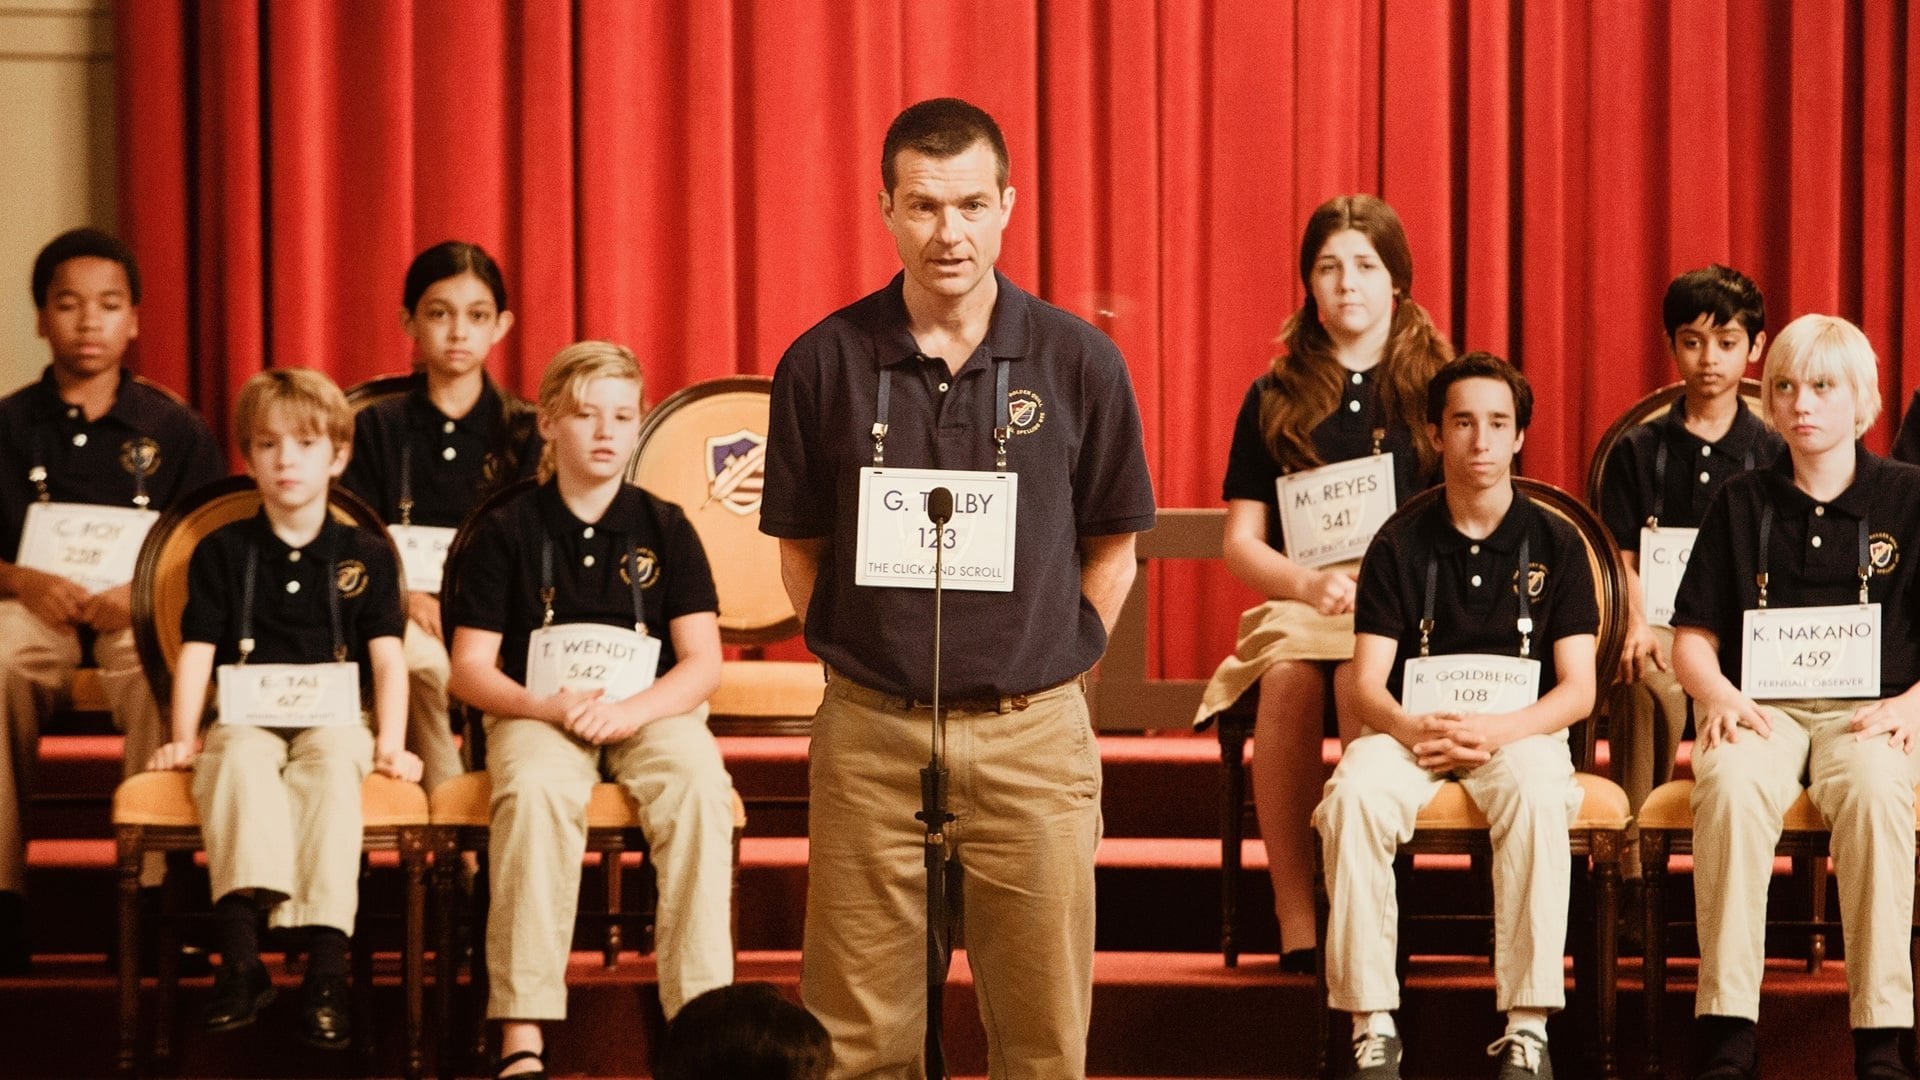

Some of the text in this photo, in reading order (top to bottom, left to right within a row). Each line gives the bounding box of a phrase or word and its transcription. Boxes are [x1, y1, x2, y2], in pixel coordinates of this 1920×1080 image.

[1295, 474, 1378, 508] M. REYES
[883, 490, 993, 514] G. TLBY
[1322, 509, 1351, 531] 341
[918, 527, 956, 549] 123
[1653, 547, 1670, 564] C.
[868, 562, 1002, 578] THE CLICK AND SCROLL
[1753, 622, 1871, 641] K. NAKANO
[562, 639, 638, 662] WENDT
[1792, 651, 1831, 667] 459
[567, 663, 606, 679] 542
[1415, 670, 1527, 686] R. GOLDBERG
[1758, 678, 1863, 688] FERNDALE OBSERVER
[1454, 688, 1488, 702] 108
